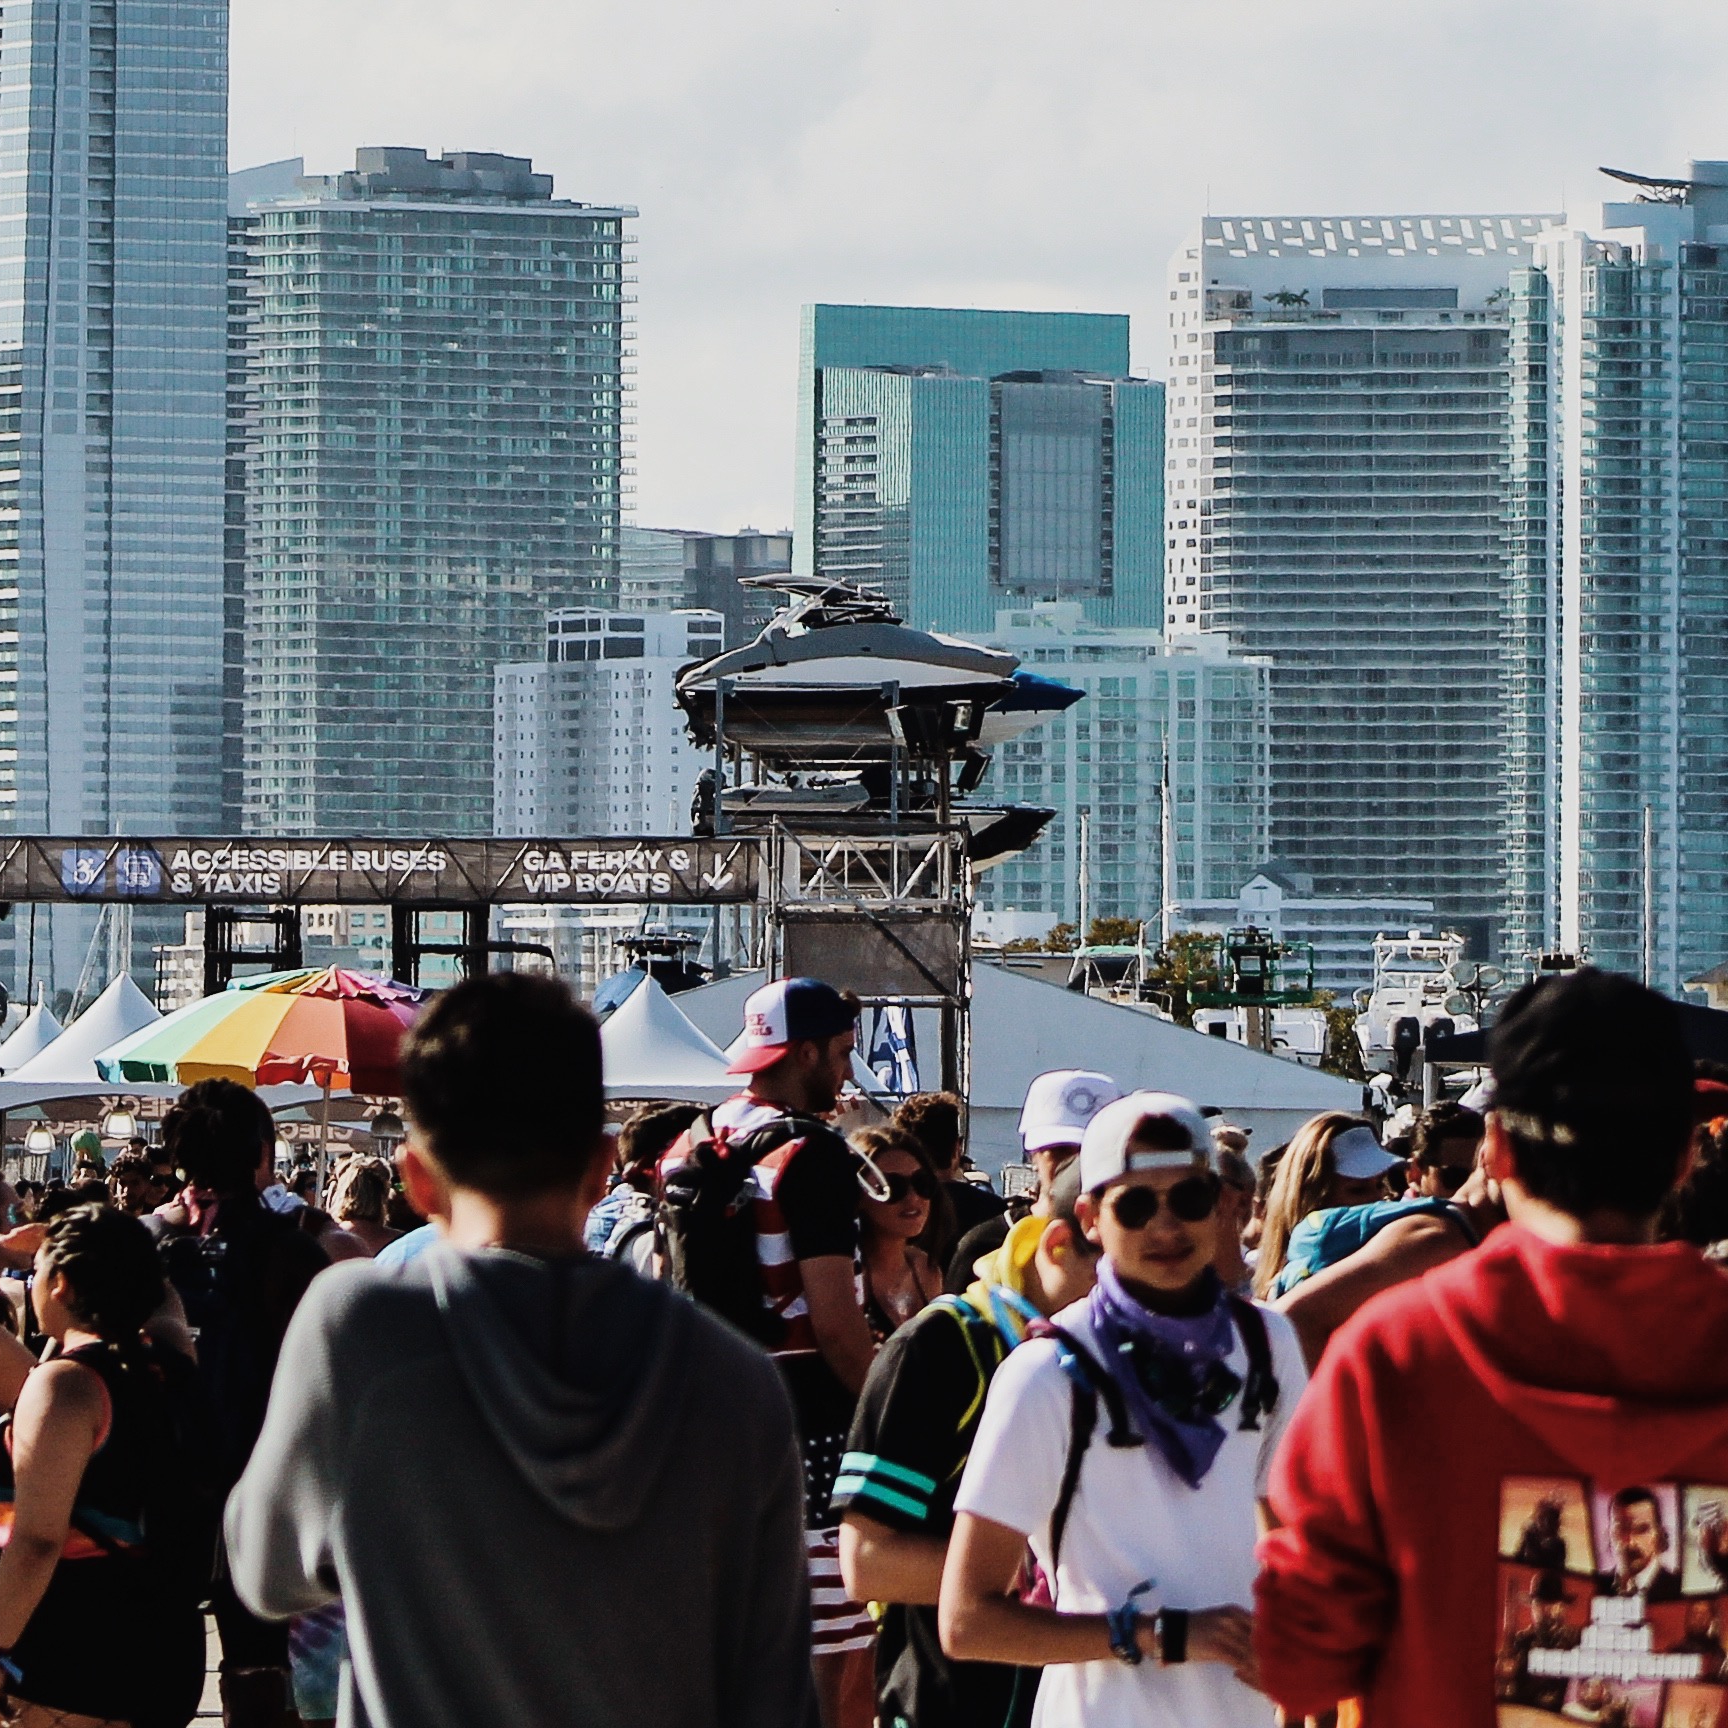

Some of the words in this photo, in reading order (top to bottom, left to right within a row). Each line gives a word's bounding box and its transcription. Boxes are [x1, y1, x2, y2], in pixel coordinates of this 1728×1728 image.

[171, 849, 347, 872] ACCESSIBLE
[351, 849, 447, 872] BUSES
[522, 850, 566, 872] GA
[570, 849, 664, 871] FERRY
[668, 849, 691, 871] &
[171, 873, 193, 895] &
[198, 873, 281, 895] TAXIS
[522, 873, 571, 894] VIP
[575, 873, 672, 895] BOATS
